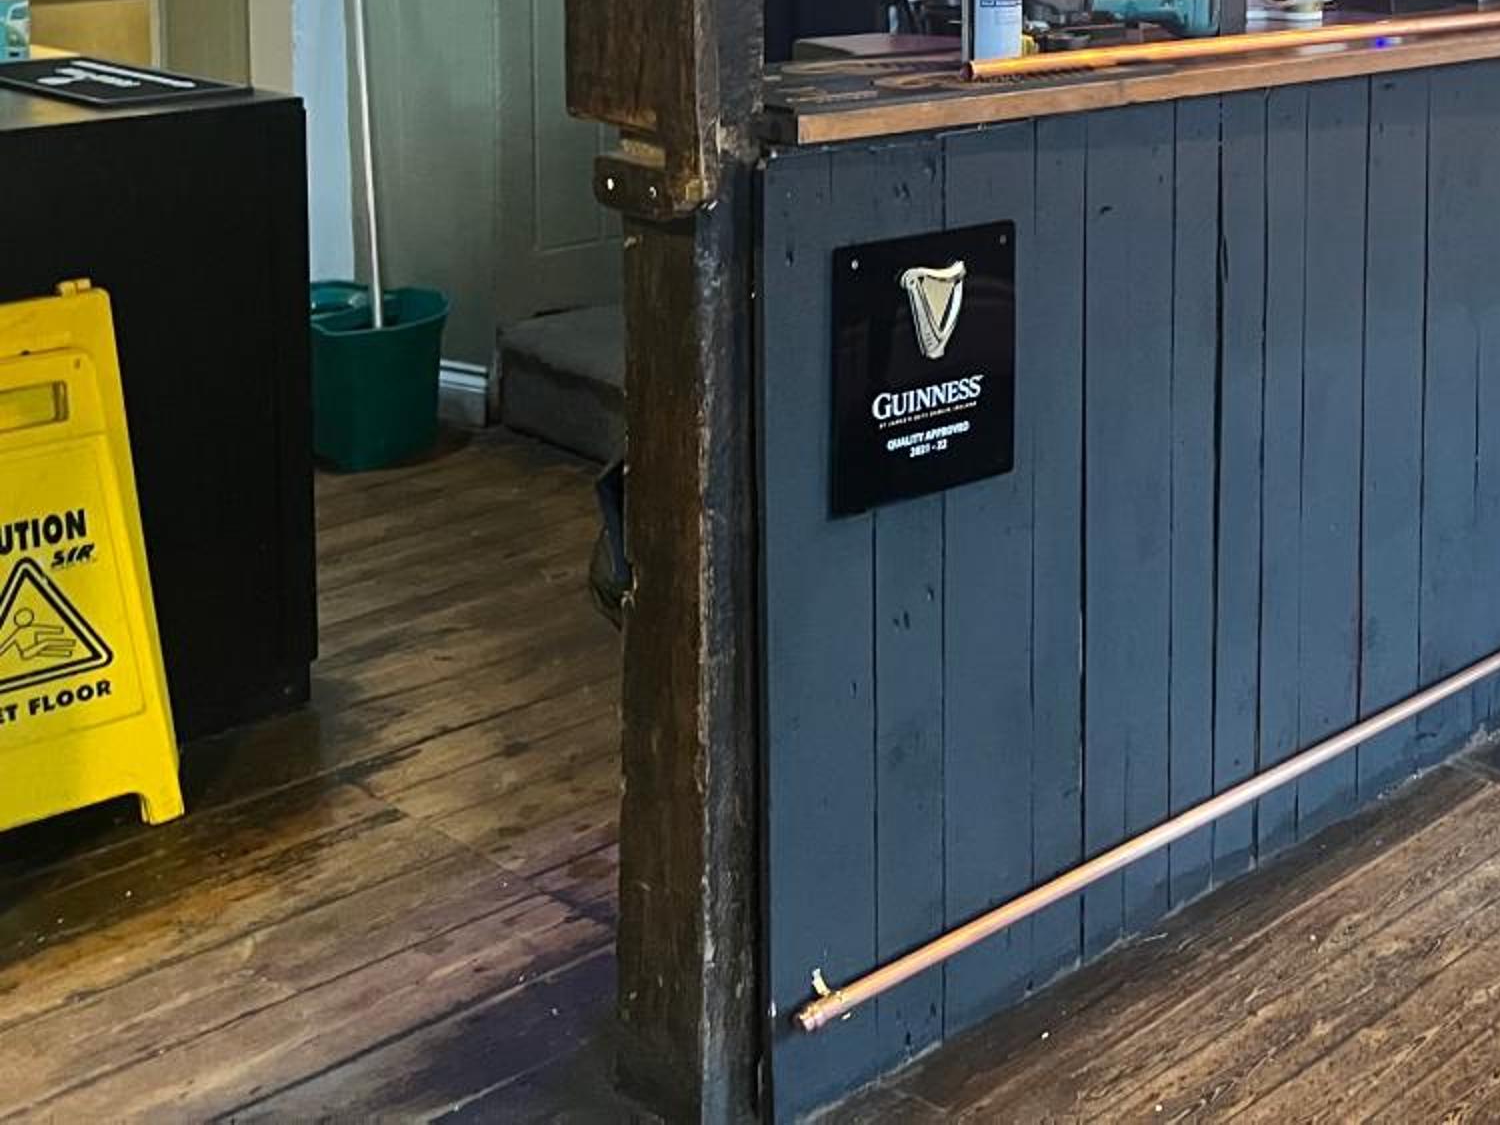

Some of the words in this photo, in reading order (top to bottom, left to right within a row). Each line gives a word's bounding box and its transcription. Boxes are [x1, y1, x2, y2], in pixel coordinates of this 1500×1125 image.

[872, 374, 984, 420] GUINNESS
[886, 432, 925, 452] QUALITY
[28, 680, 112, 716] FLOOR
